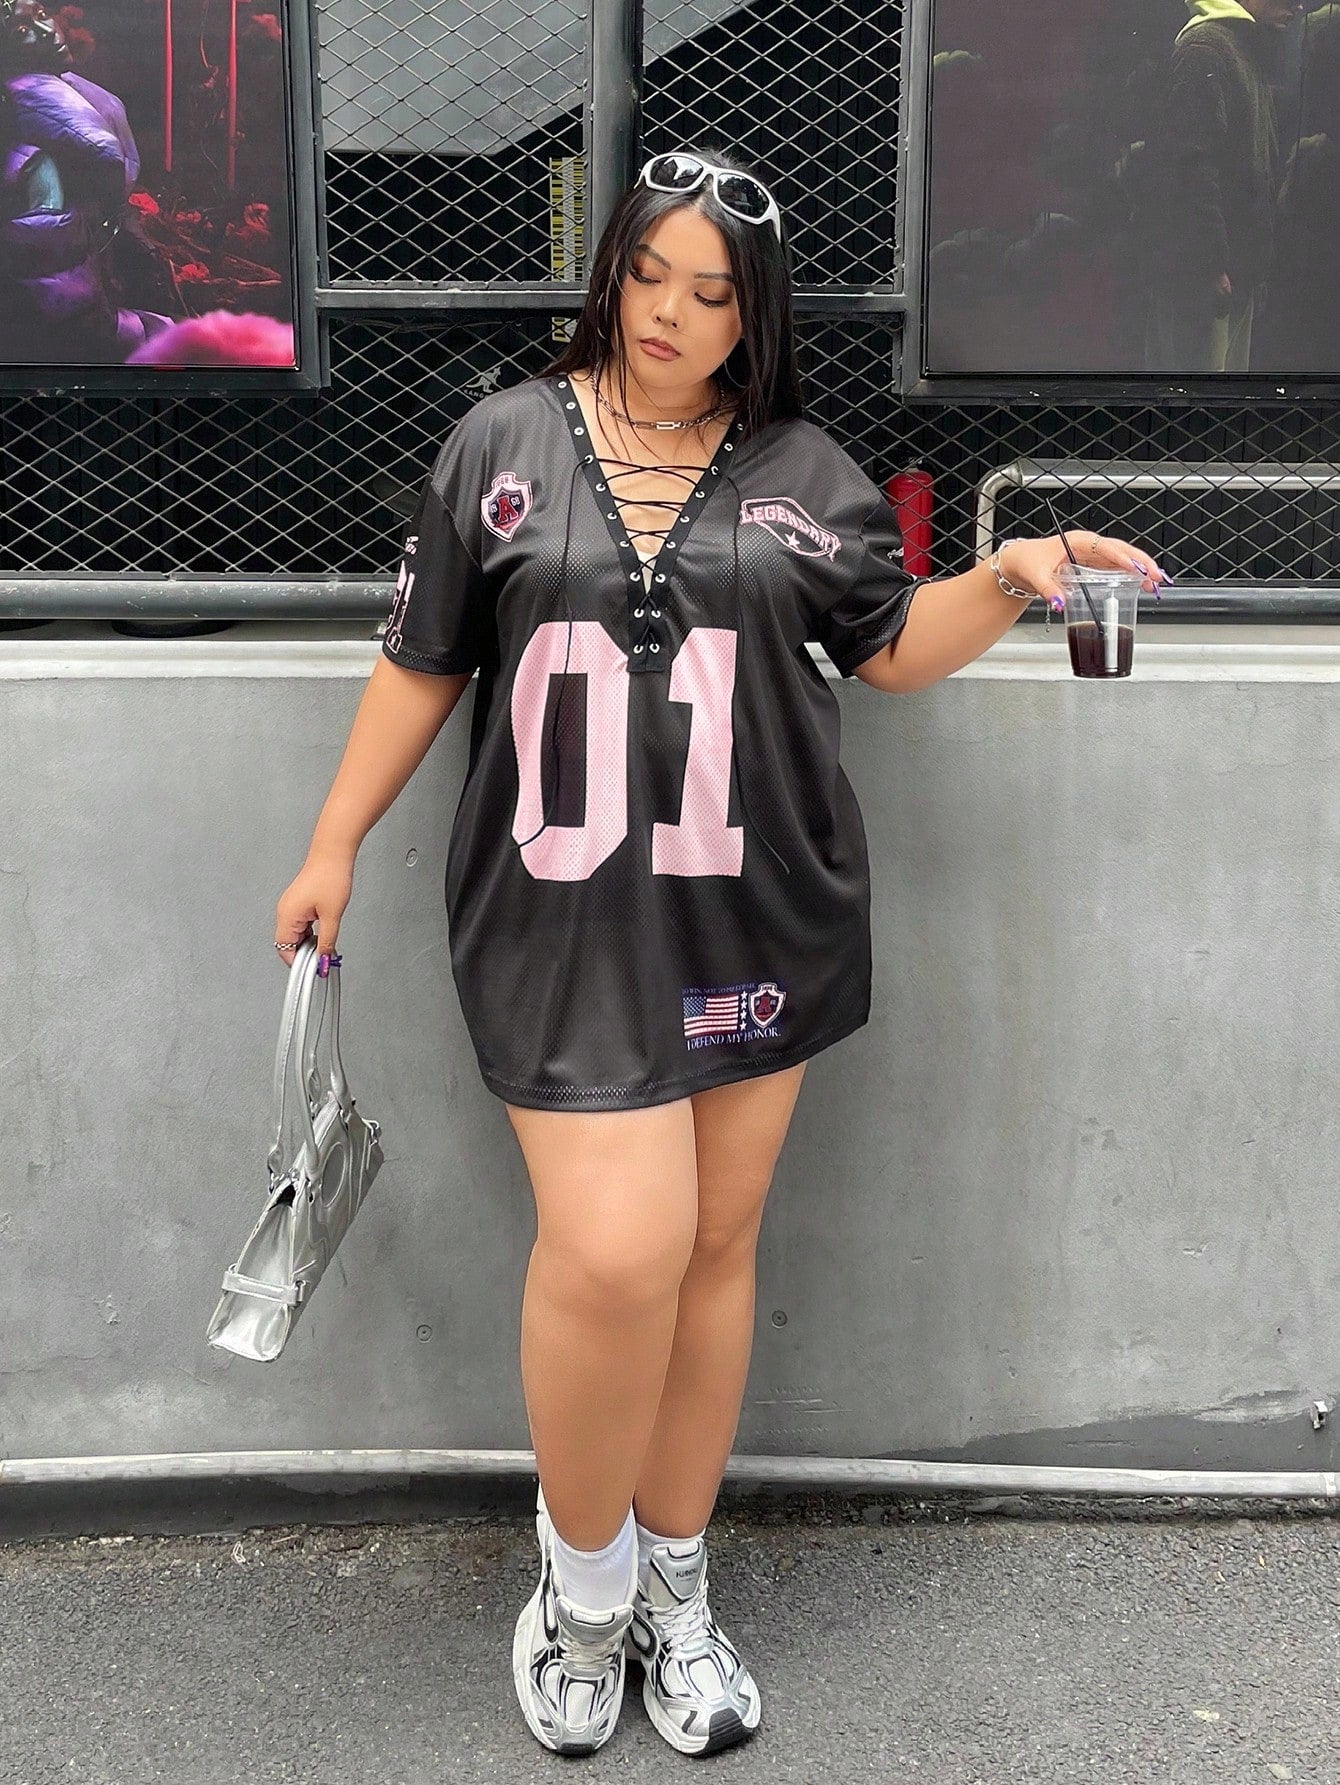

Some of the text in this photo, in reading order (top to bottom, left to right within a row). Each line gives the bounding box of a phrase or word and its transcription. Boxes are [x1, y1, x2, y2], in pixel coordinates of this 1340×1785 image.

[463, 389, 486, 399] KANG
[497, 495, 519, 523] A
[739, 504, 842, 562] LEGENDARY
[511, 621, 744, 881] 01
[686, 1039, 691, 1051] I
[691, 1034, 724, 1049] DEFEND
[727, 1032, 743, 1043] MY
